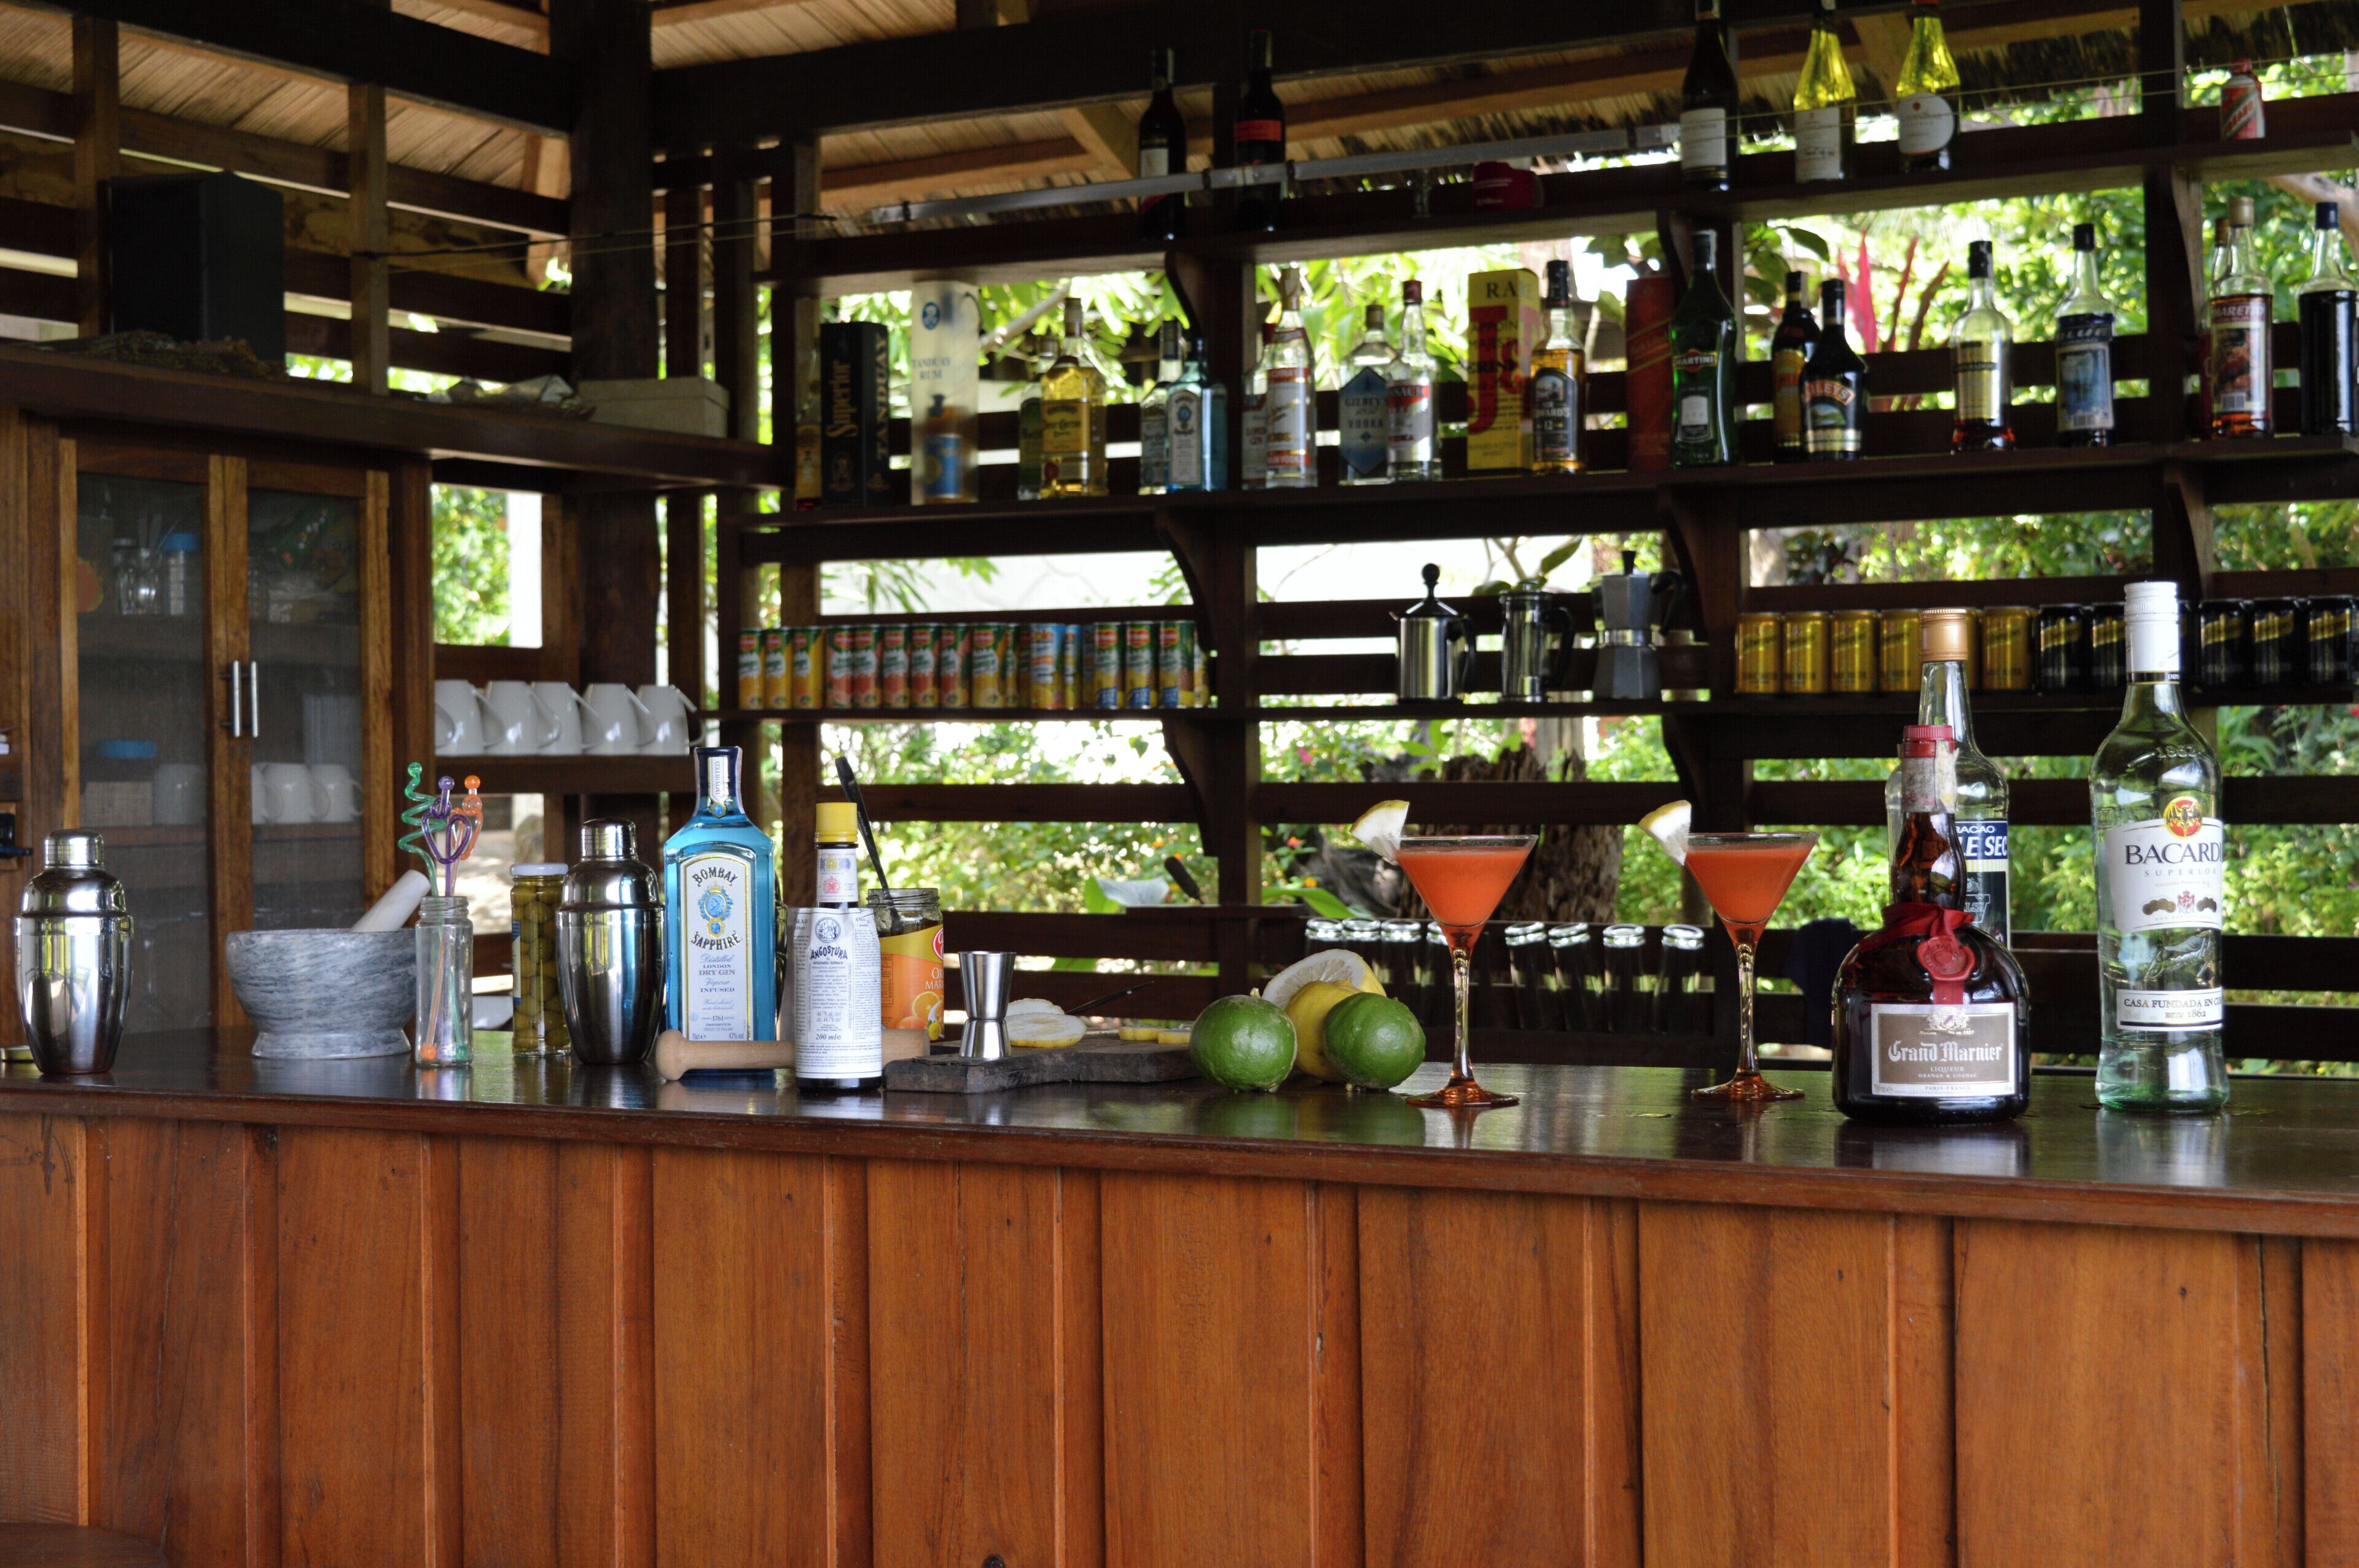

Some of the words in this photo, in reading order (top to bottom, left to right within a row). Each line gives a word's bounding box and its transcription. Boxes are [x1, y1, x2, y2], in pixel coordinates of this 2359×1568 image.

[1677, 355, 1715, 366] MARTINI
[1347, 419, 1383, 429] VODKA
[1985, 836, 2007, 856] SEC
[692, 867, 738, 887] BOMBAY
[2144, 867, 2217, 877] SUPERIOR
[690, 931, 741, 950] SAPPHIRE
[810, 946, 848, 959] ANGOSTURA
[699, 953, 735, 964] Distilled
[2124, 999, 2149, 1007] CASA
[2151, 999, 2202, 1008] FUNDADA
[2187, 1008, 2206, 1018] 1862
[1888, 1040, 1938, 1063] Grand
[1939, 1041, 2003, 1062] Marnier
